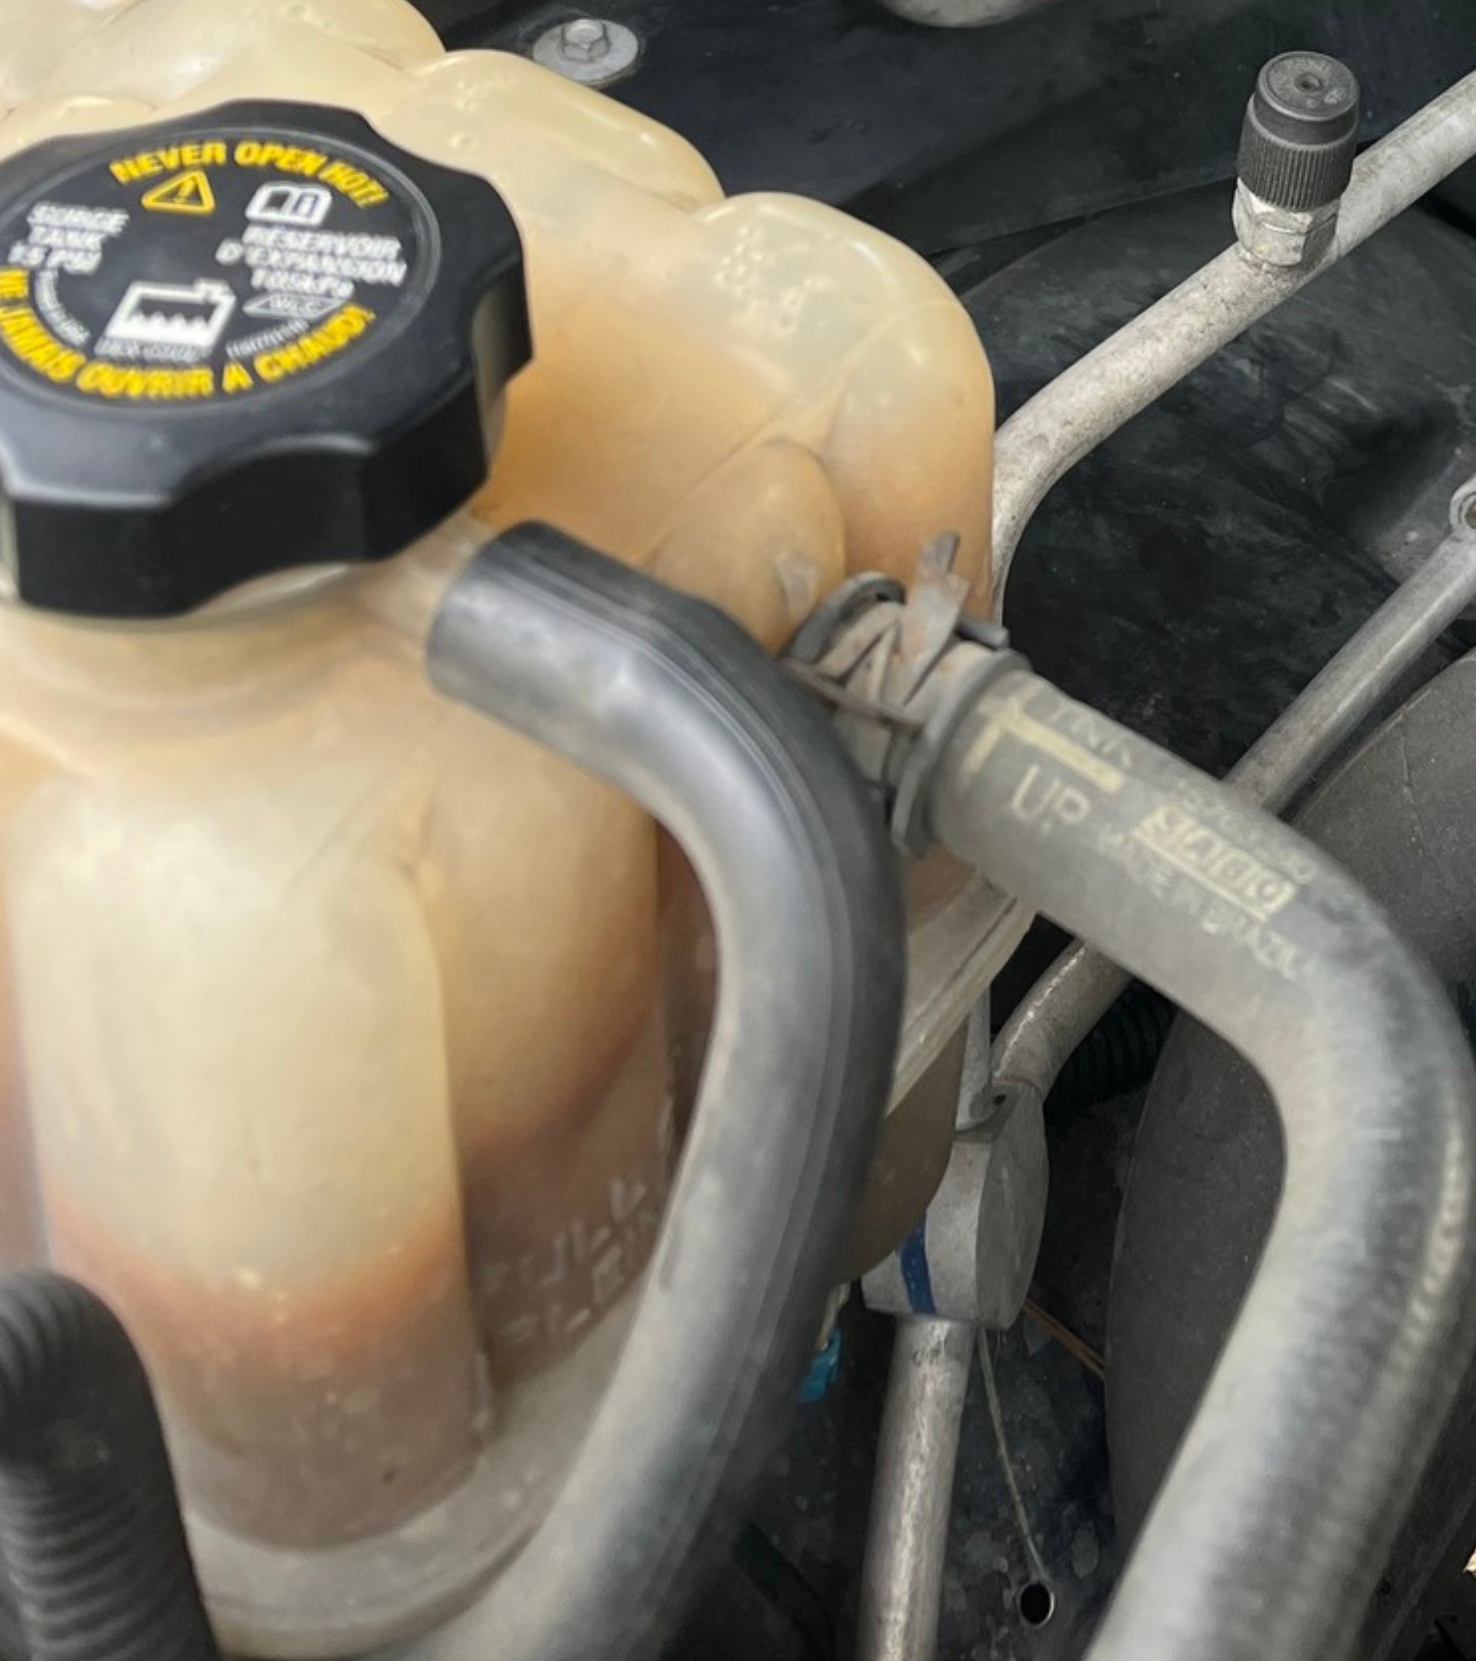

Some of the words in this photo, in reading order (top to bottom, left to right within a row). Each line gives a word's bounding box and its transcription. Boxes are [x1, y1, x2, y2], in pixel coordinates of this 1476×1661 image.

[109, 142, 228, 184] NEVER
[233, 140, 328, 177] OPEN
[26, 200, 130, 238] SURGE
[28, 225, 105, 254] TANK
[75, 358, 215, 400] OUVRIR
[1012, 760, 1091, 834] UP
